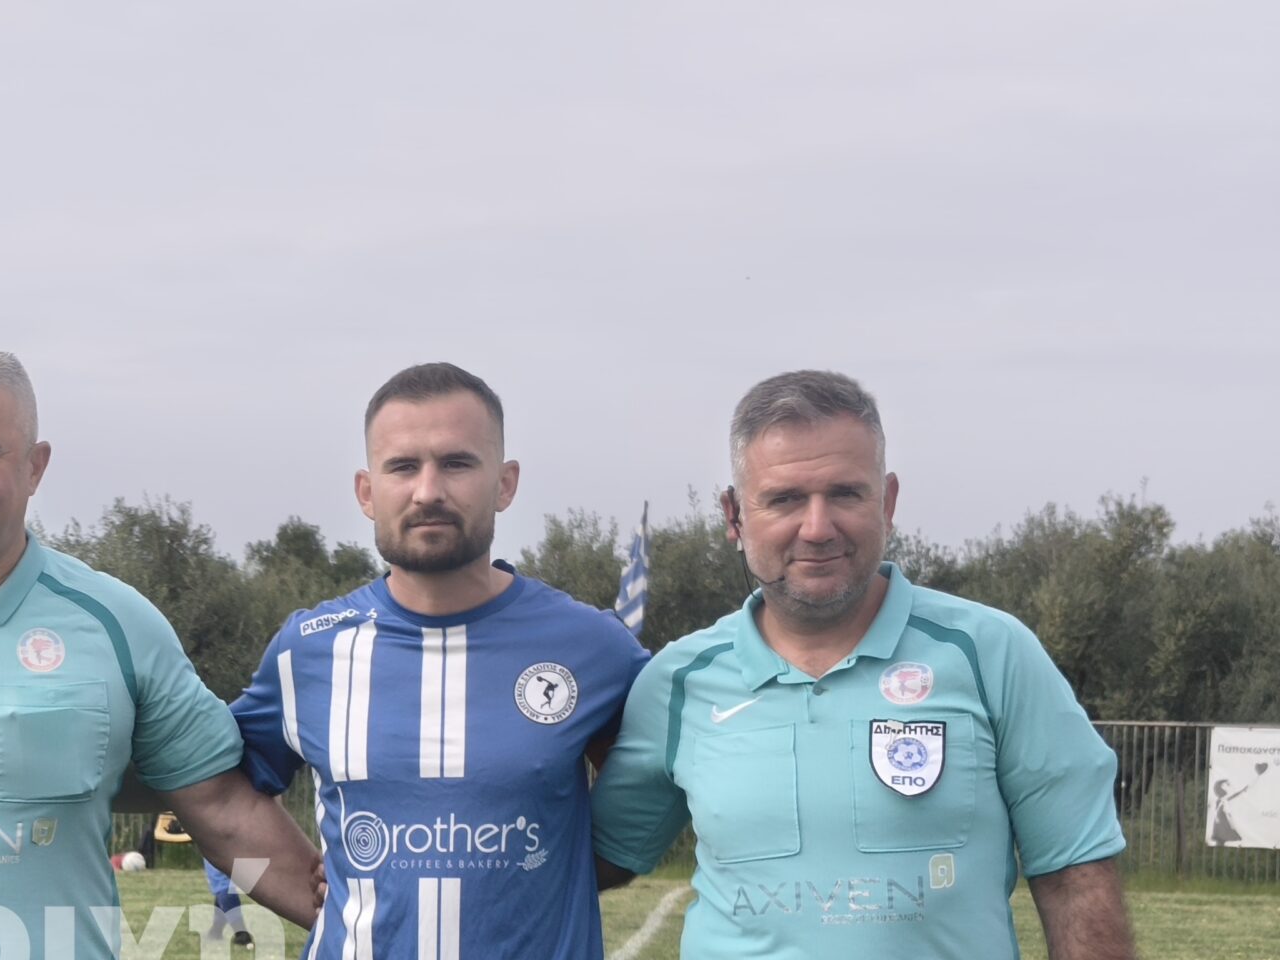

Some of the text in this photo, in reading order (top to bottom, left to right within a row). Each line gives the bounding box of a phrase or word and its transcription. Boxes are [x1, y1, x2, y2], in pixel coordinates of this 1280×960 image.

[891, 775, 925, 787] ΕΠΟ
[337, 786, 539, 871] brother's
[390, 859, 509, 870] COFFEE & BAKERY
[732, 875, 925, 916] AXIVEN
